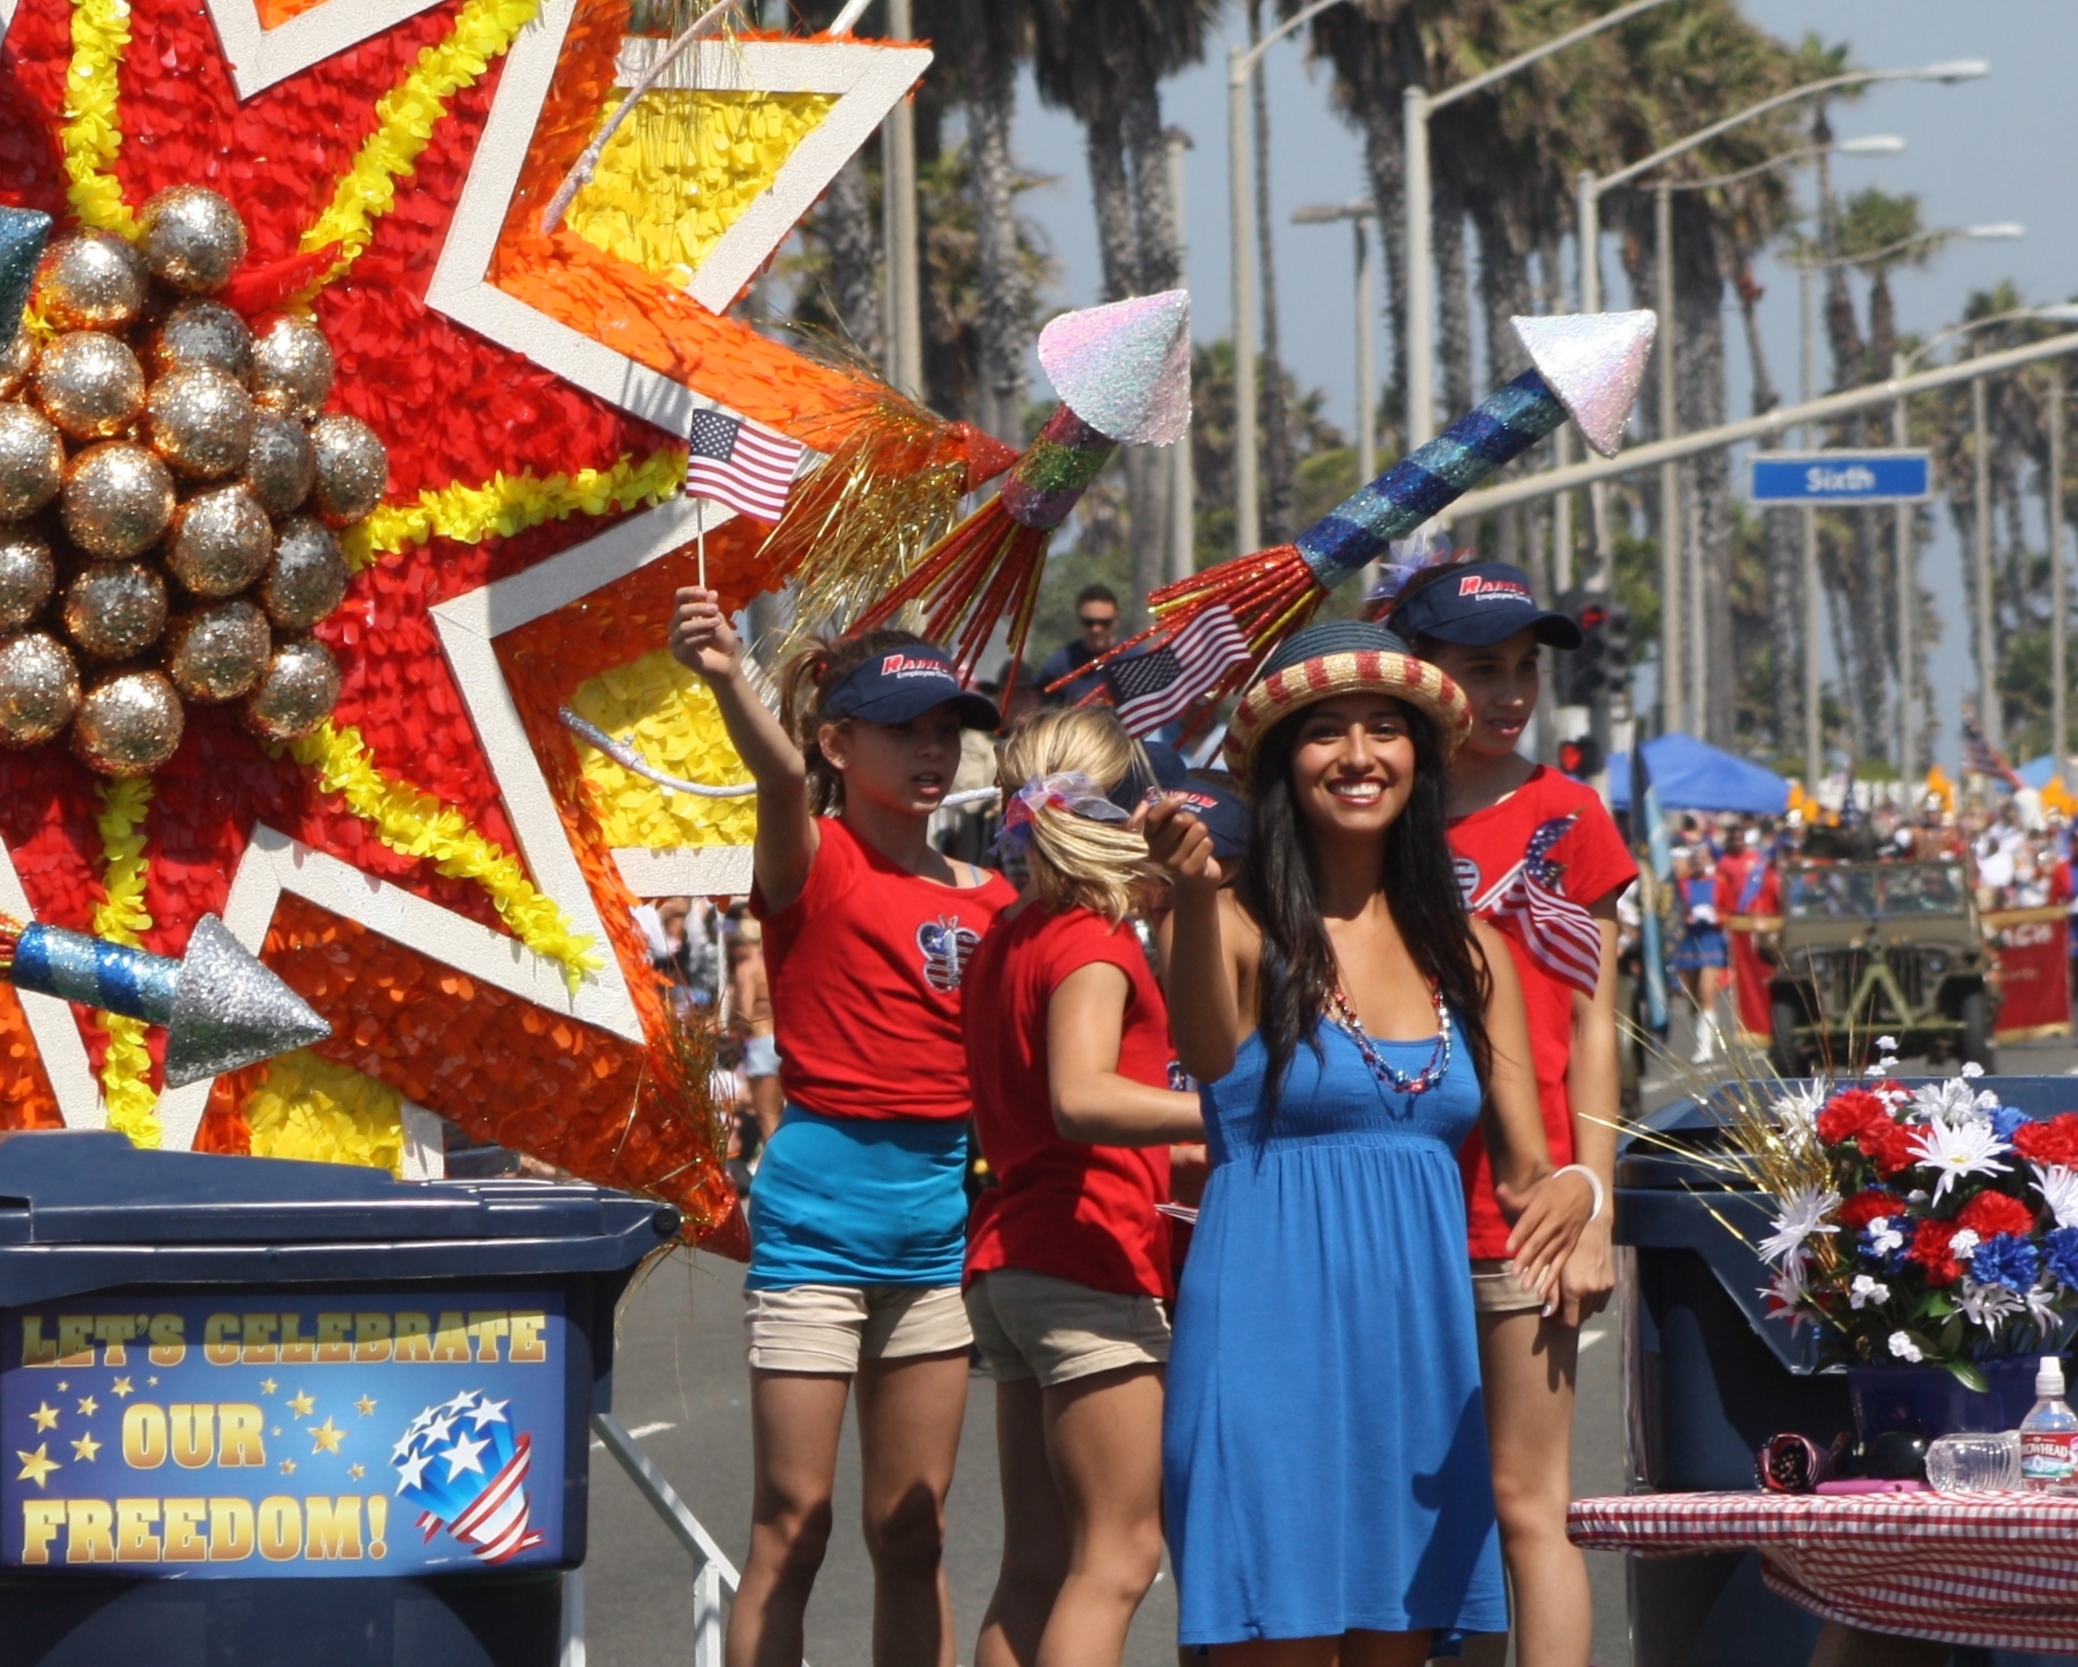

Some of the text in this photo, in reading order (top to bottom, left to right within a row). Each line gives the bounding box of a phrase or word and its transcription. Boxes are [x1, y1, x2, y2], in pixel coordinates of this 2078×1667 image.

[1806, 465, 1875, 492] Sixth
[22, 1310, 548, 1368] LET'S CELEBRATE
[121, 1402, 266, 1470] OUR
[21, 1494, 390, 1565] FREEDOM!
